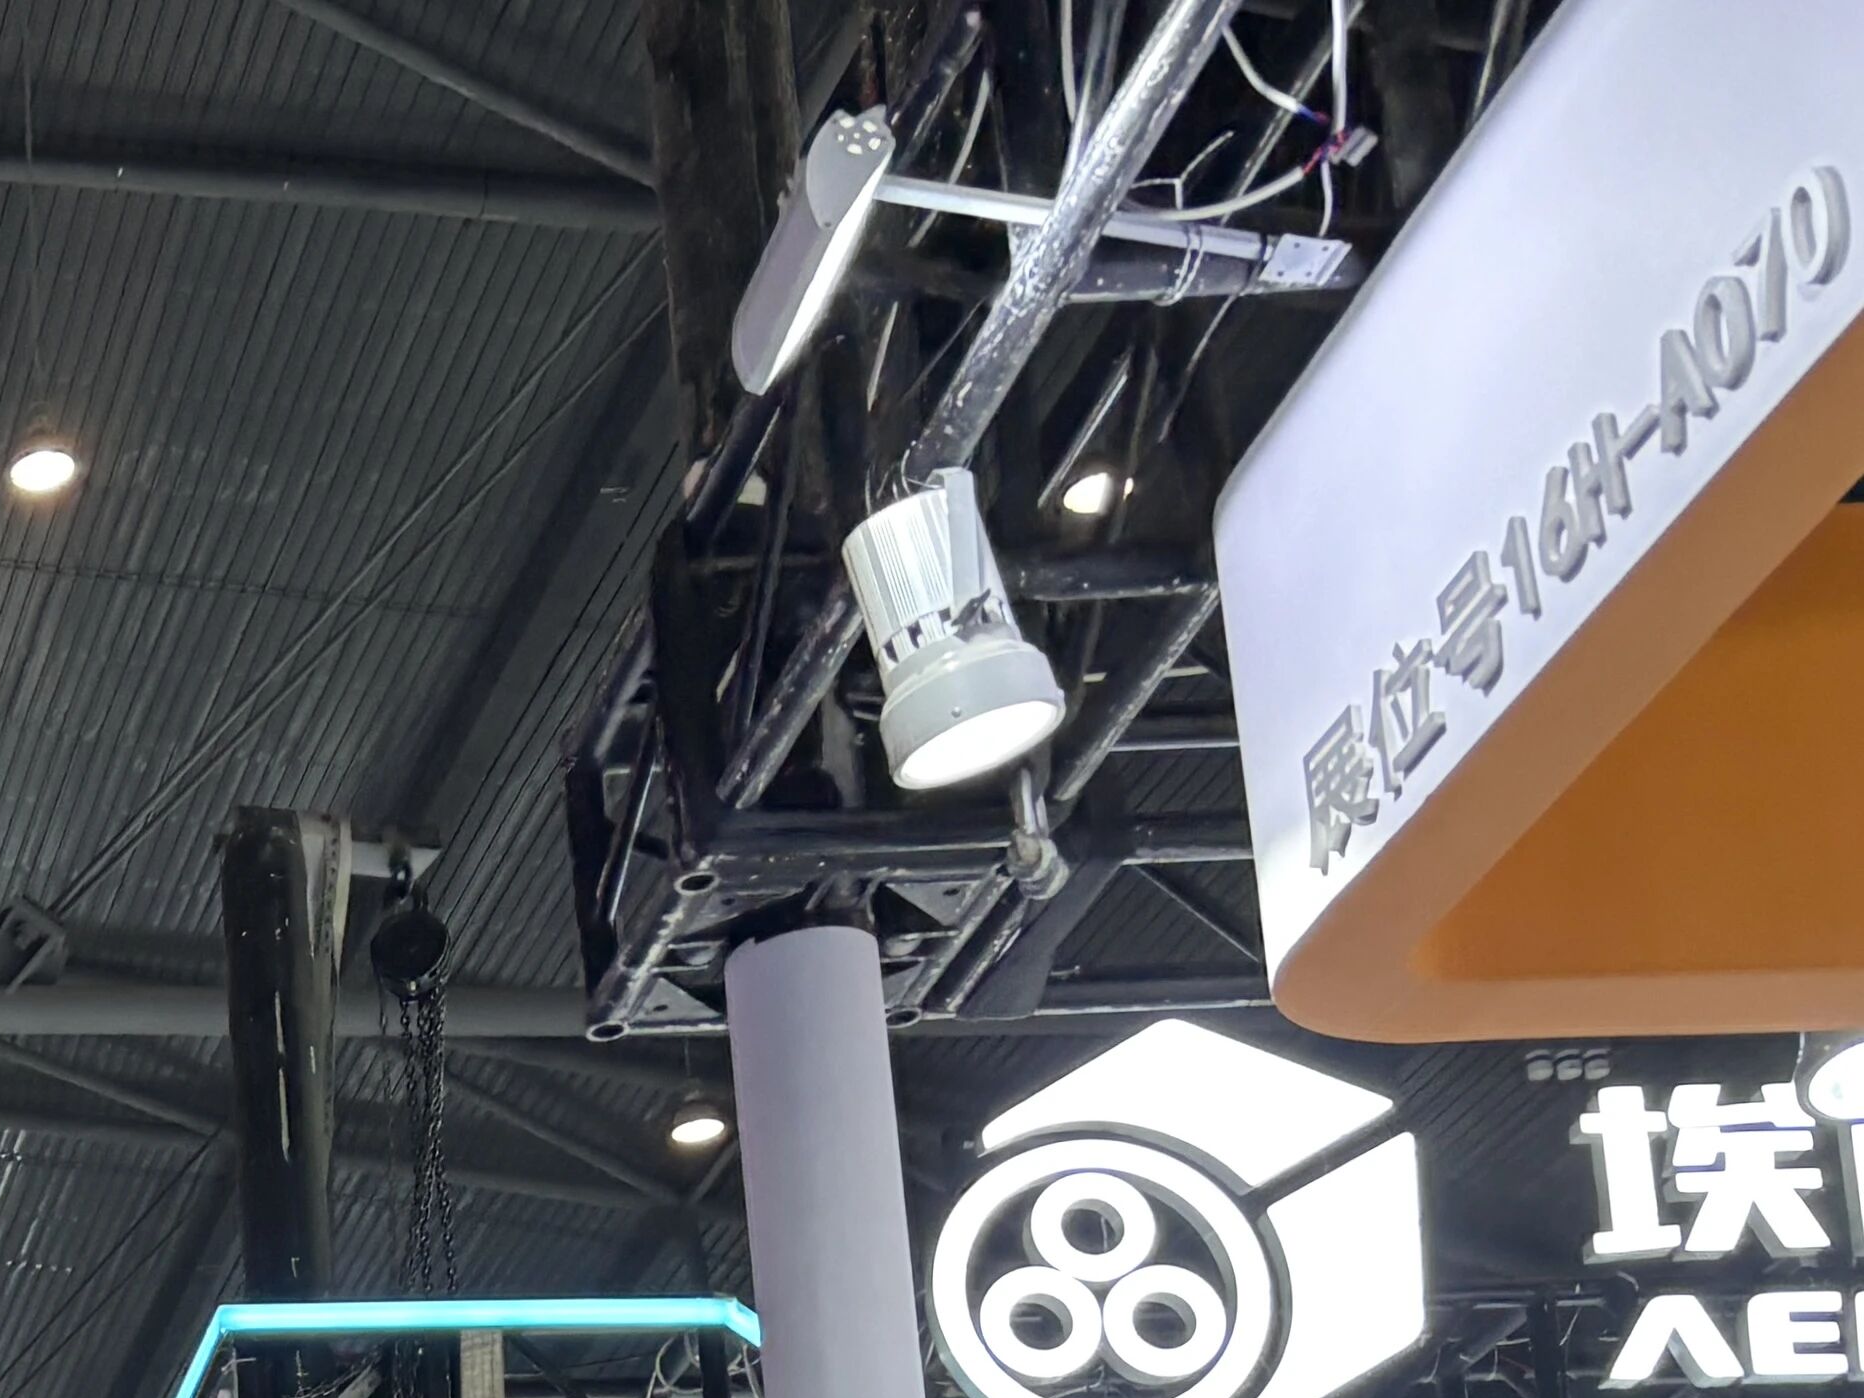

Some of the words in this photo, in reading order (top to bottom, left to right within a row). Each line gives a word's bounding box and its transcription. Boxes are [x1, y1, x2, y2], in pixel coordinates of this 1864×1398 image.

[1302, 165, 1852, 875] 展位号16H-A070
[1579, 1083, 1864, 1259] 埃
